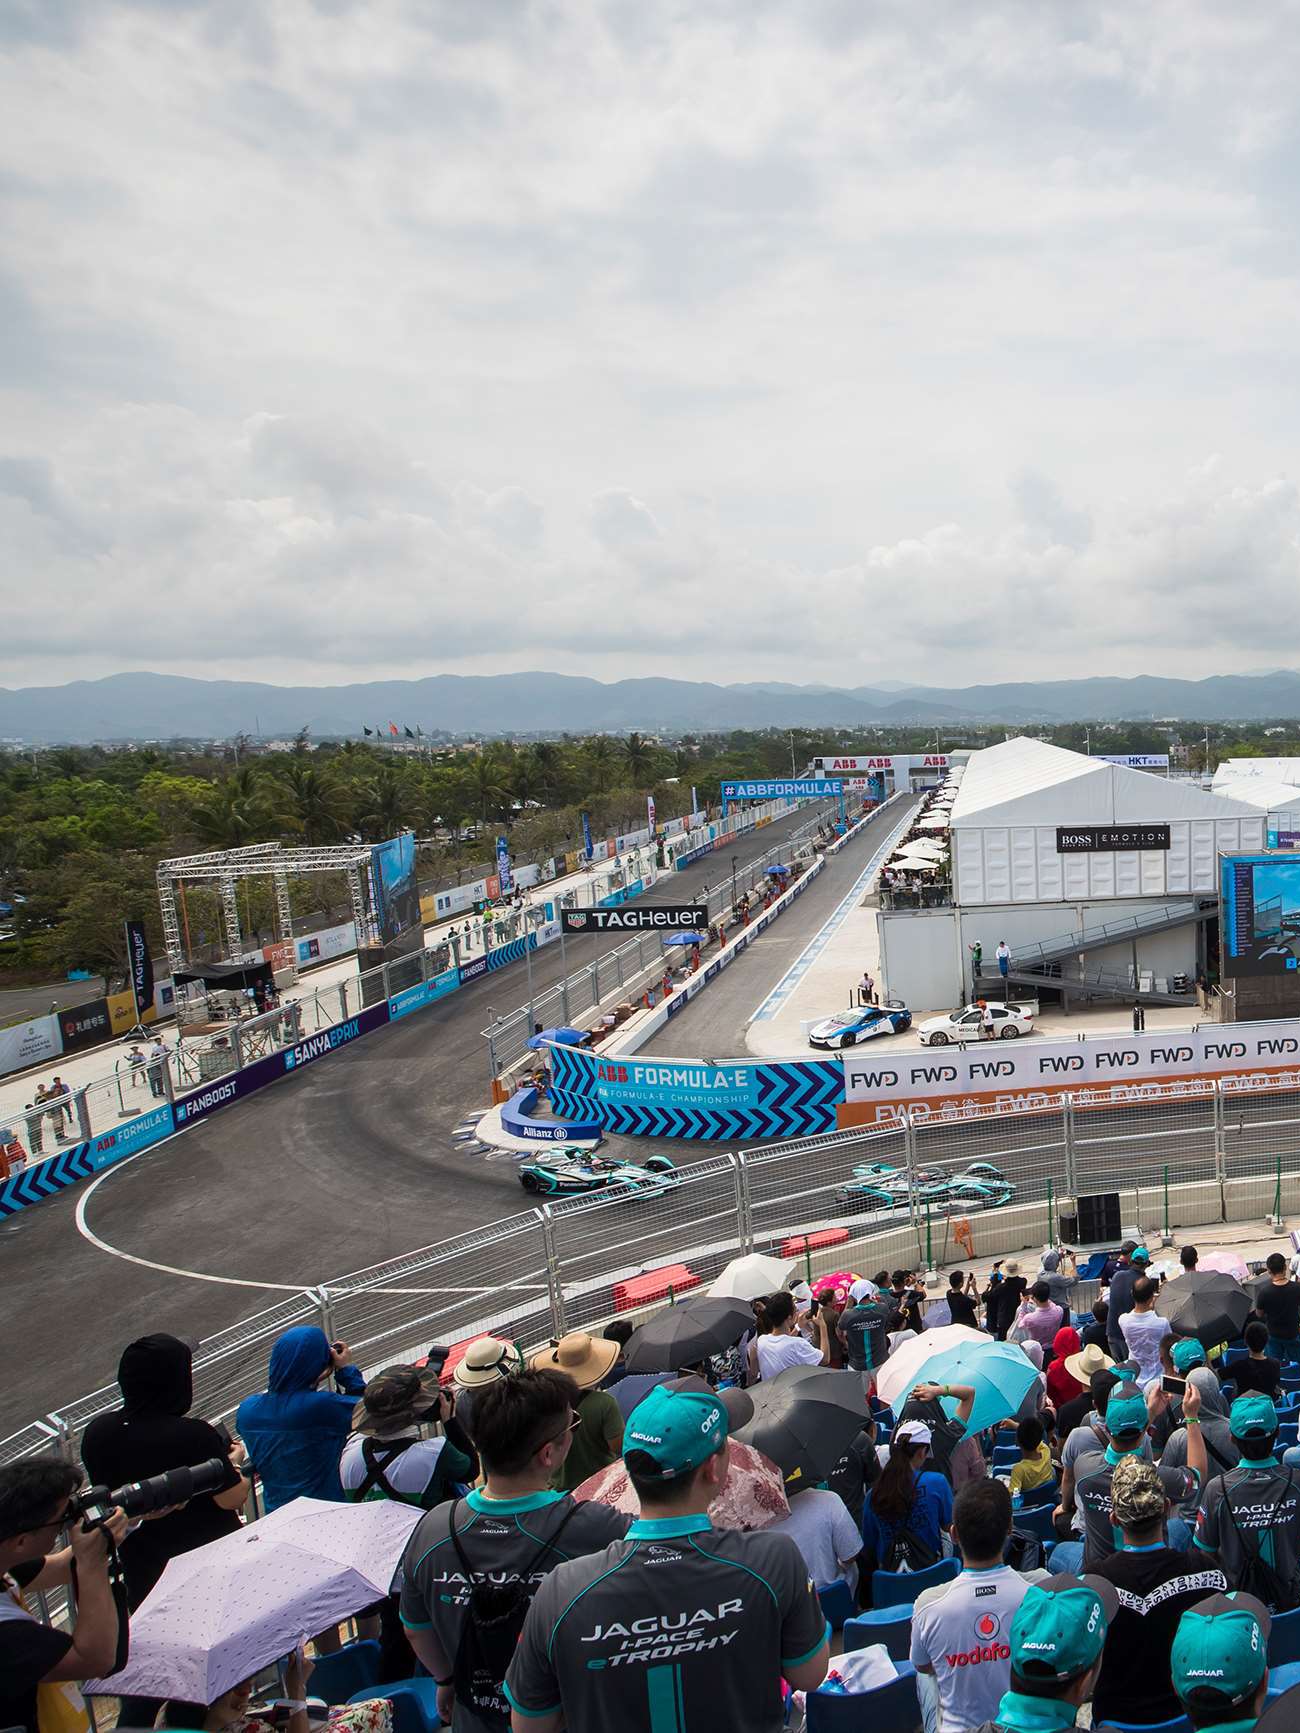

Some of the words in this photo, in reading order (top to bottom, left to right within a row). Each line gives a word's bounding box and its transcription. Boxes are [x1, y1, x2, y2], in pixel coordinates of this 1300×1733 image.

[833, 759, 857, 769] ABB
[867, 758, 892, 768] ABB
[923, 756, 947, 766] ABB
[1128, 757, 1148, 765] HKT
[1061, 835, 1092, 845] BOSS
[1101, 833, 1165, 843] EMOTION
[851, 1071, 899, 1089] FWD
[910, 1066, 958, 1084] FWD
[969, 1060, 1015, 1079] FWD
[1039, 1055, 1085, 1073] FWD
[1095, 1050, 1139, 1068] FWD
[1150, 1046, 1194, 1064] FWD
[1204, 1042, 1246, 1059] FWD
[1257, 1038, 1298, 1055] FWD
[598, 1065, 629, 1083] ABB
[634, 1067, 749, 1089] FORMULA-E
[176, 1081, 237, 1122] #FANBOOST
[610, 1091, 665, 1101] FORMULA-E
[671, 1094, 750, 1105] CHAMPIONSHIP
[875, 1102, 930, 1123] FWD
[523, 1127, 553, 1139] Allianz
[97, 1135, 116, 1152] ABB
[701, 1408, 721, 1433] one
[630, 1432, 663, 1443] JAGUAR
[1232, 1499, 1297, 1514] JAGUAR
[643, 1555, 683, 1565] JAGUAR
[976, 1586, 996, 1596] BOSS
[581, 1598, 744, 1641] JAGUAR
[1087, 1602, 1100, 1632] one
[620, 1628, 705, 1650] I-PACE
[1251, 1622, 1259, 1651] one
[586, 1629, 740, 1670] eTROPHY
[1022, 1642, 1057, 1650] JAGUAR
[945, 1642, 1011, 1667] vodafo
[1186, 1669, 1224, 1677] JAGUAR
